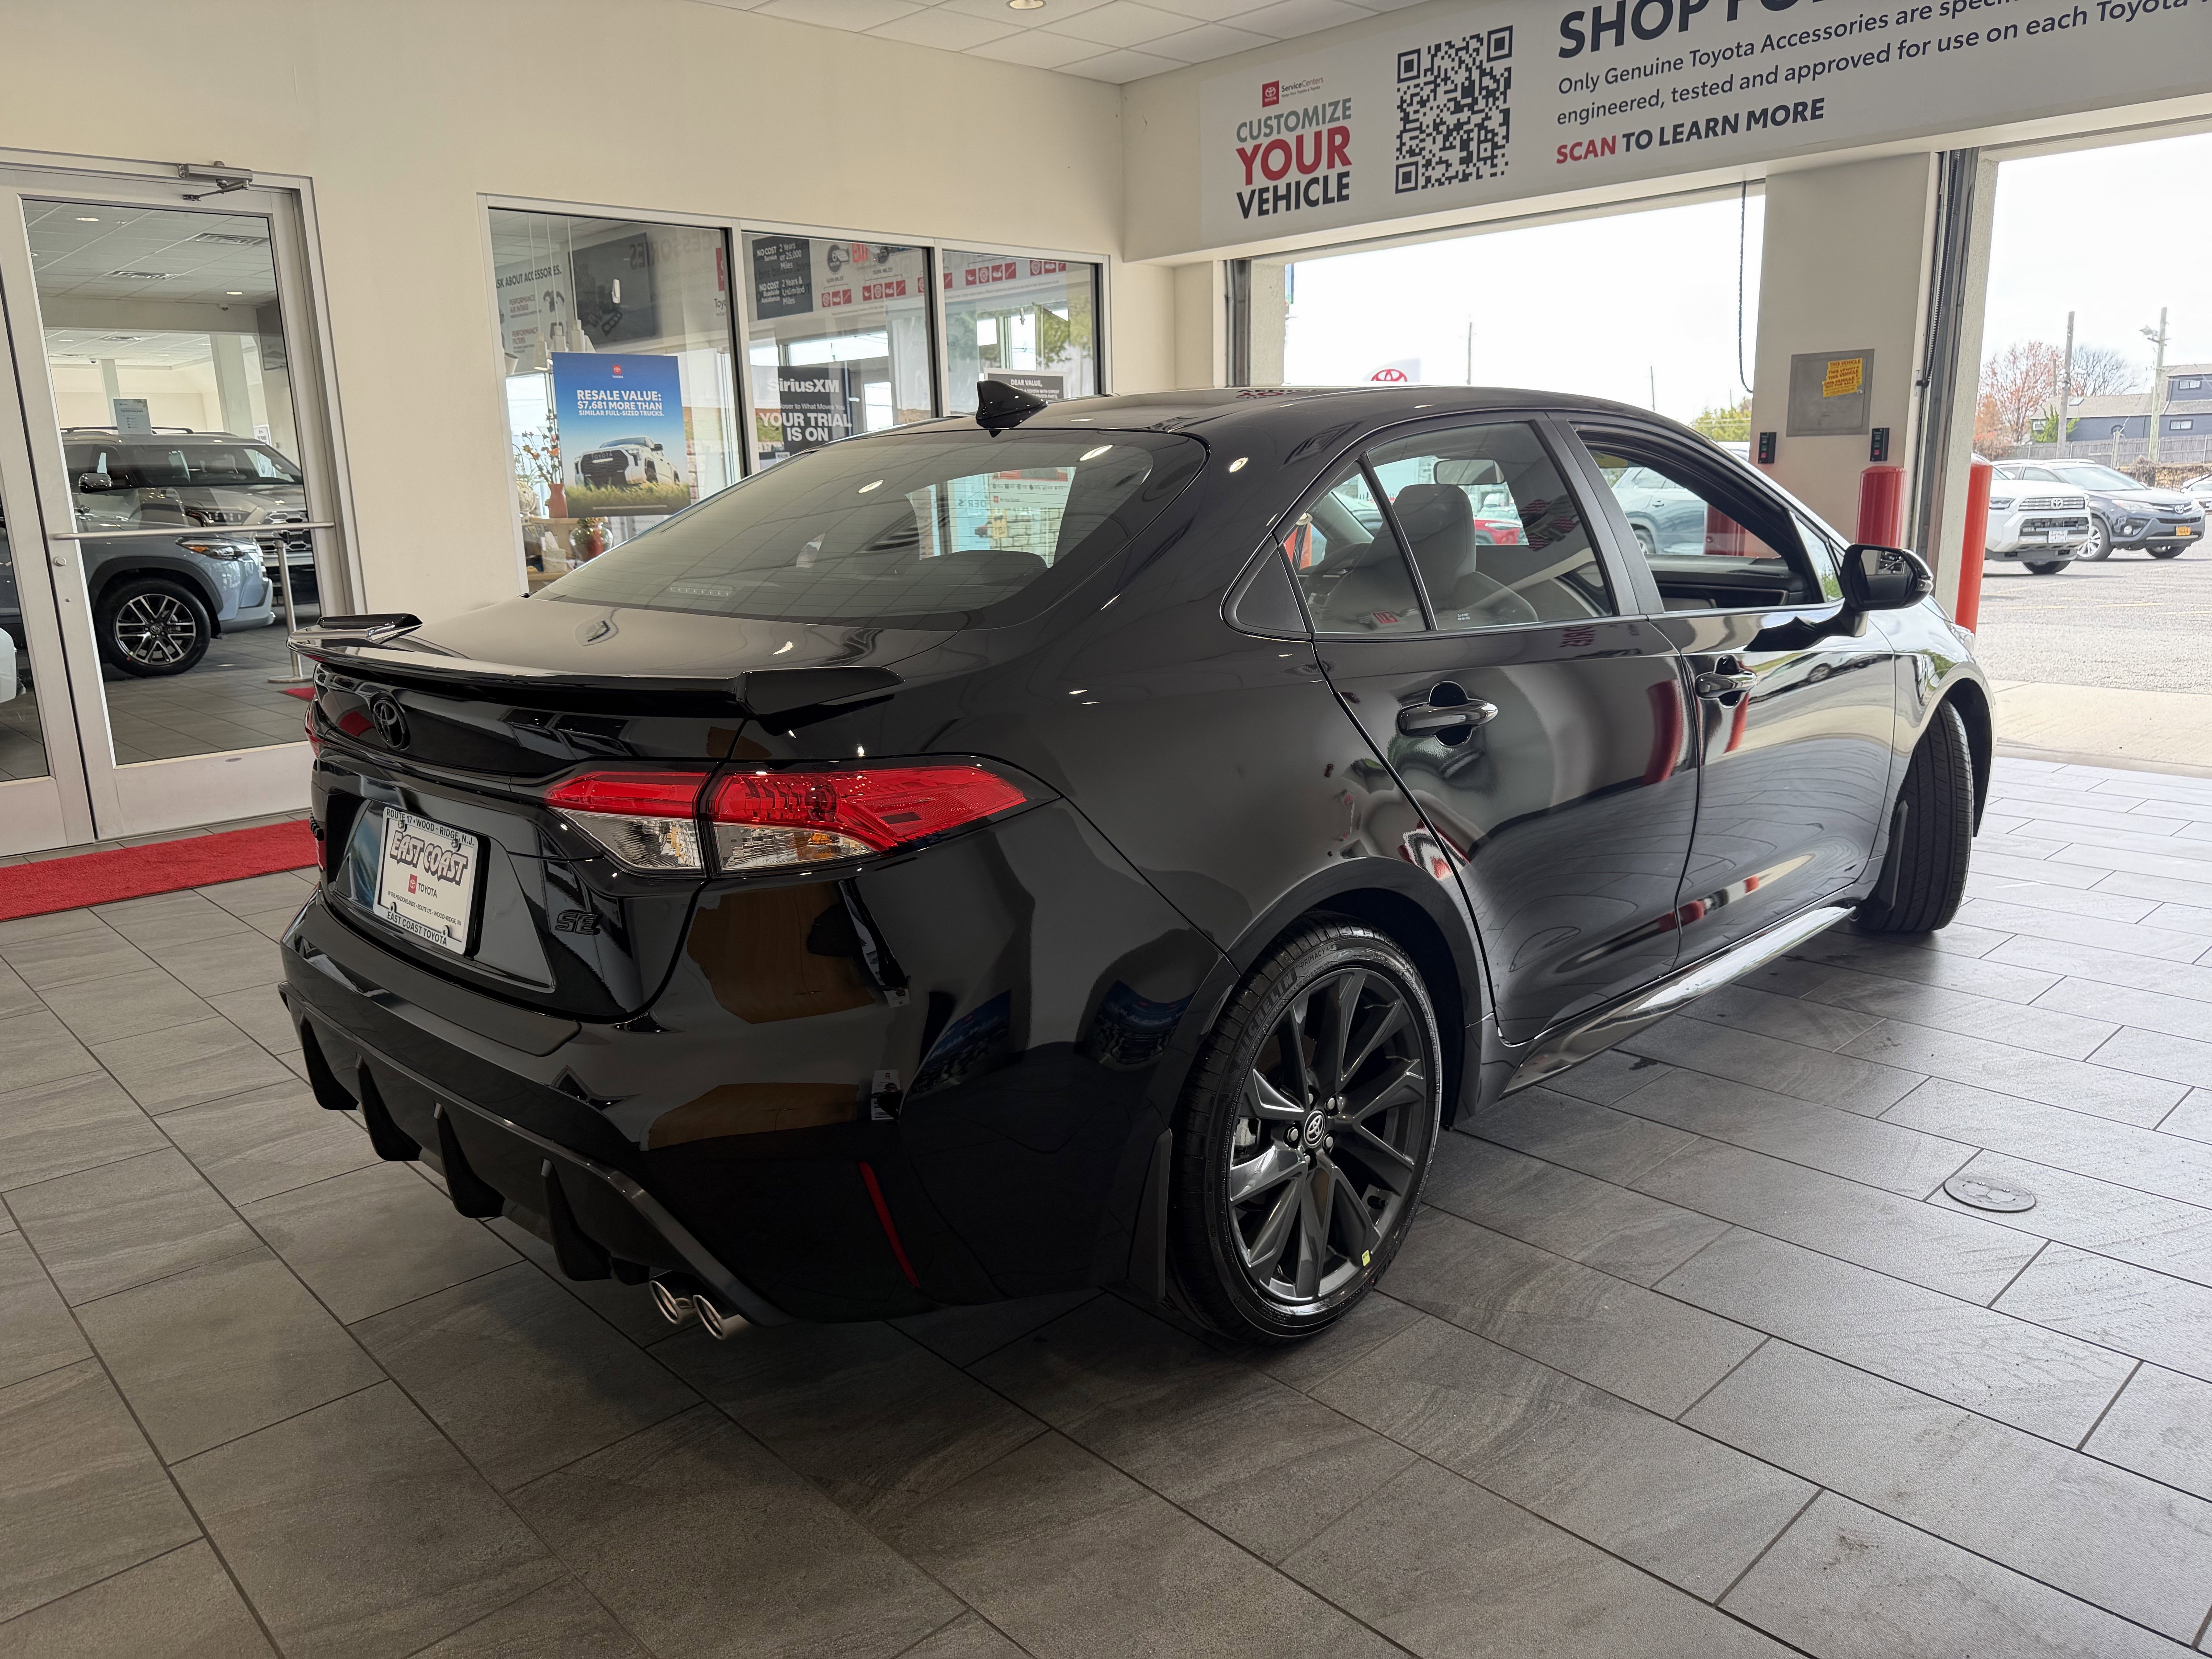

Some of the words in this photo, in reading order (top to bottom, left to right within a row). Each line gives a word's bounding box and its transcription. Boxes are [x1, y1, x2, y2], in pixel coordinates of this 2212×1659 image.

[1558, 72, 1599, 94] Only
[1604, 56, 1684, 85] Genuine
[1689, 41, 1754, 68] Toyota
[1760, 14, 1889, 53] Accessories
[1895, 5, 1932, 26] are
[1557, 89, 1665, 125] engineered,
[1671, 74, 1733, 103] tested
[1739, 65, 1778, 90] and
[1784, 43, 1891, 84] approved
[1897, 39, 1931, 60] for
[1937, 32, 1979, 53] use
[1986, 24, 2018, 43] on
[2026, 6, 2088, 35] each
[1281, 77, 1324, 92] ServiceCenters
[1237, 97, 1352, 143] CUSTOMIZE
[1556, 135, 1616, 164] SCAN
[1622, 130, 1653, 153] TO
[1659, 113, 1739, 146] LEARN
[1746, 97, 1825, 131] MORE
[1236, 125, 1352, 186] YOUR
[1236, 171, 1350, 220] VEHICLE
[765, 246, 777, 255] COST
[784, 243, 796, 251] Years
[786, 250, 802, 260] 25,000
[780, 261, 793, 270] Miles
[496, 277, 504, 289] SK
[505, 273, 523, 287] ABOUT
[524, 264, 562, 283] ACCESSORES.
[767, 281, 779, 290] COST
[781, 286, 805, 296] Unlimited
[767, 378, 840, 393] SiriusXM
[577, 390, 620, 401] RESALE
[621, 390, 661, 401] VALUE:
[577, 401, 607, 410] $7,681
[609, 402, 636, 410] MORE
[637, 402, 662, 410] THAN
[759, 412, 805, 426] YOUR
[807, 412, 852, 427] TRIAL
[787, 427, 802, 441] IS
[805, 427, 829, 441] ON
[386, 808, 406, 822] ROUTE
[407, 815, 412, 824] 17
[416, 818, 434, 831] WOOD
[440, 828, 460, 841] RIDGE,
[462, 835, 474, 846] N.J.
[390, 830, 425, 869] EAST
[423, 843, 469, 886] COAST
[418, 882, 437, 898] TOYOTA
[417, 904, 427, 912] ROUTE
[387, 911, 401, 924] EAST
[402, 918, 422, 934] COAST
[423, 929, 447, 946] TOYOTA
[555, 909, 603, 936] SE
[1300, 948, 1325, 969] PRIMACY
[1234, 969, 1296, 1064] MICHELIN
